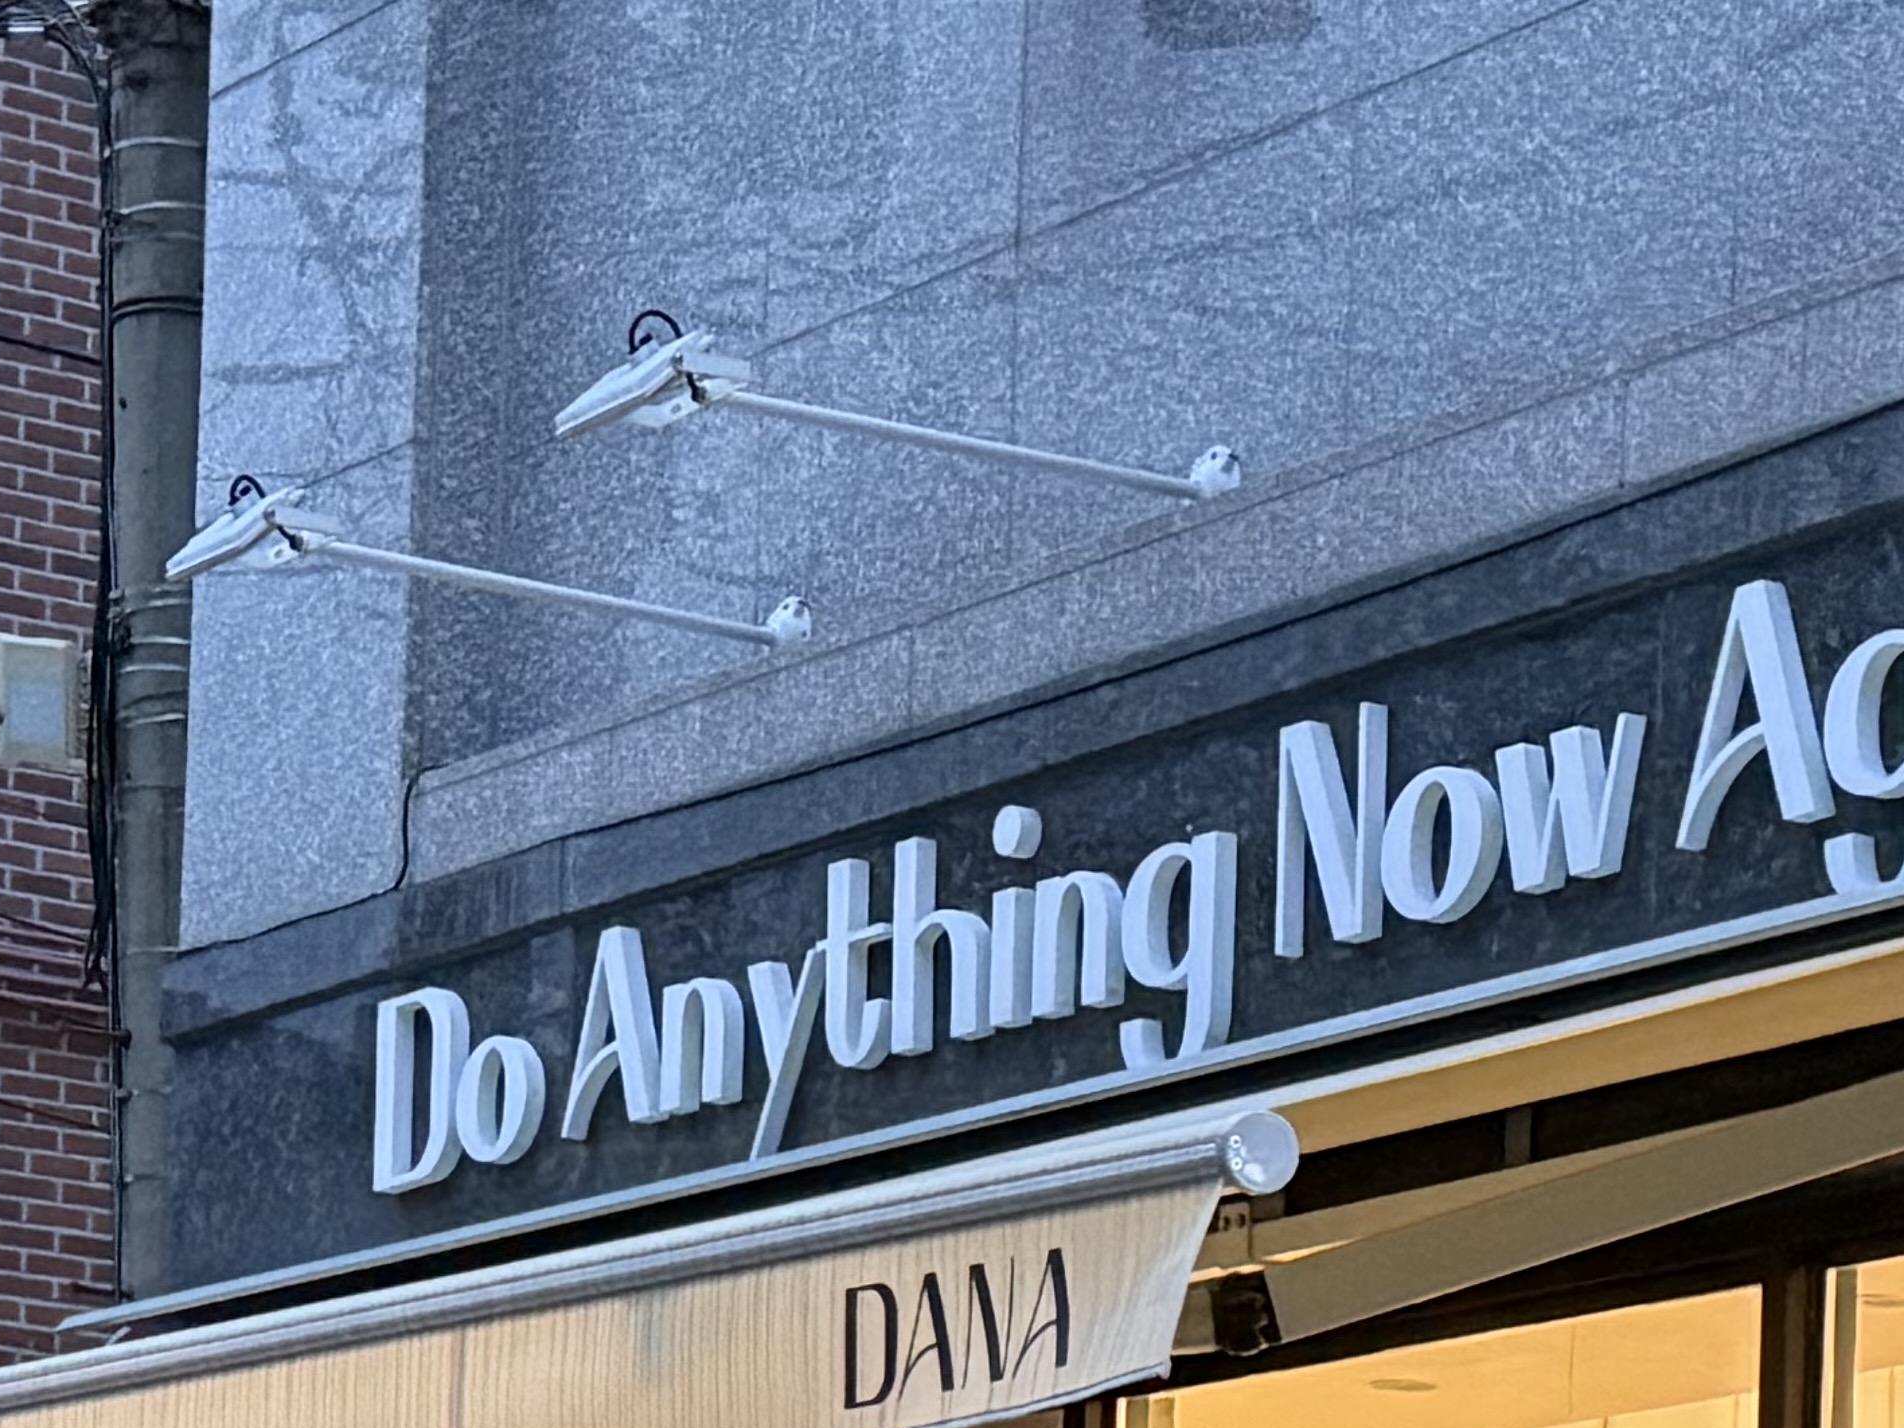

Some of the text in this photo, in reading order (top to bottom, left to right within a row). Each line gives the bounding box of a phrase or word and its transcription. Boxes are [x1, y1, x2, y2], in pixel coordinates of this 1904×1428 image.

[373, 984, 544, 1197] Do
[562, 804, 1239, 1160] Anything
[1275, 700, 1646, 960] Now
[842, 1246, 1070, 1410] DANA
